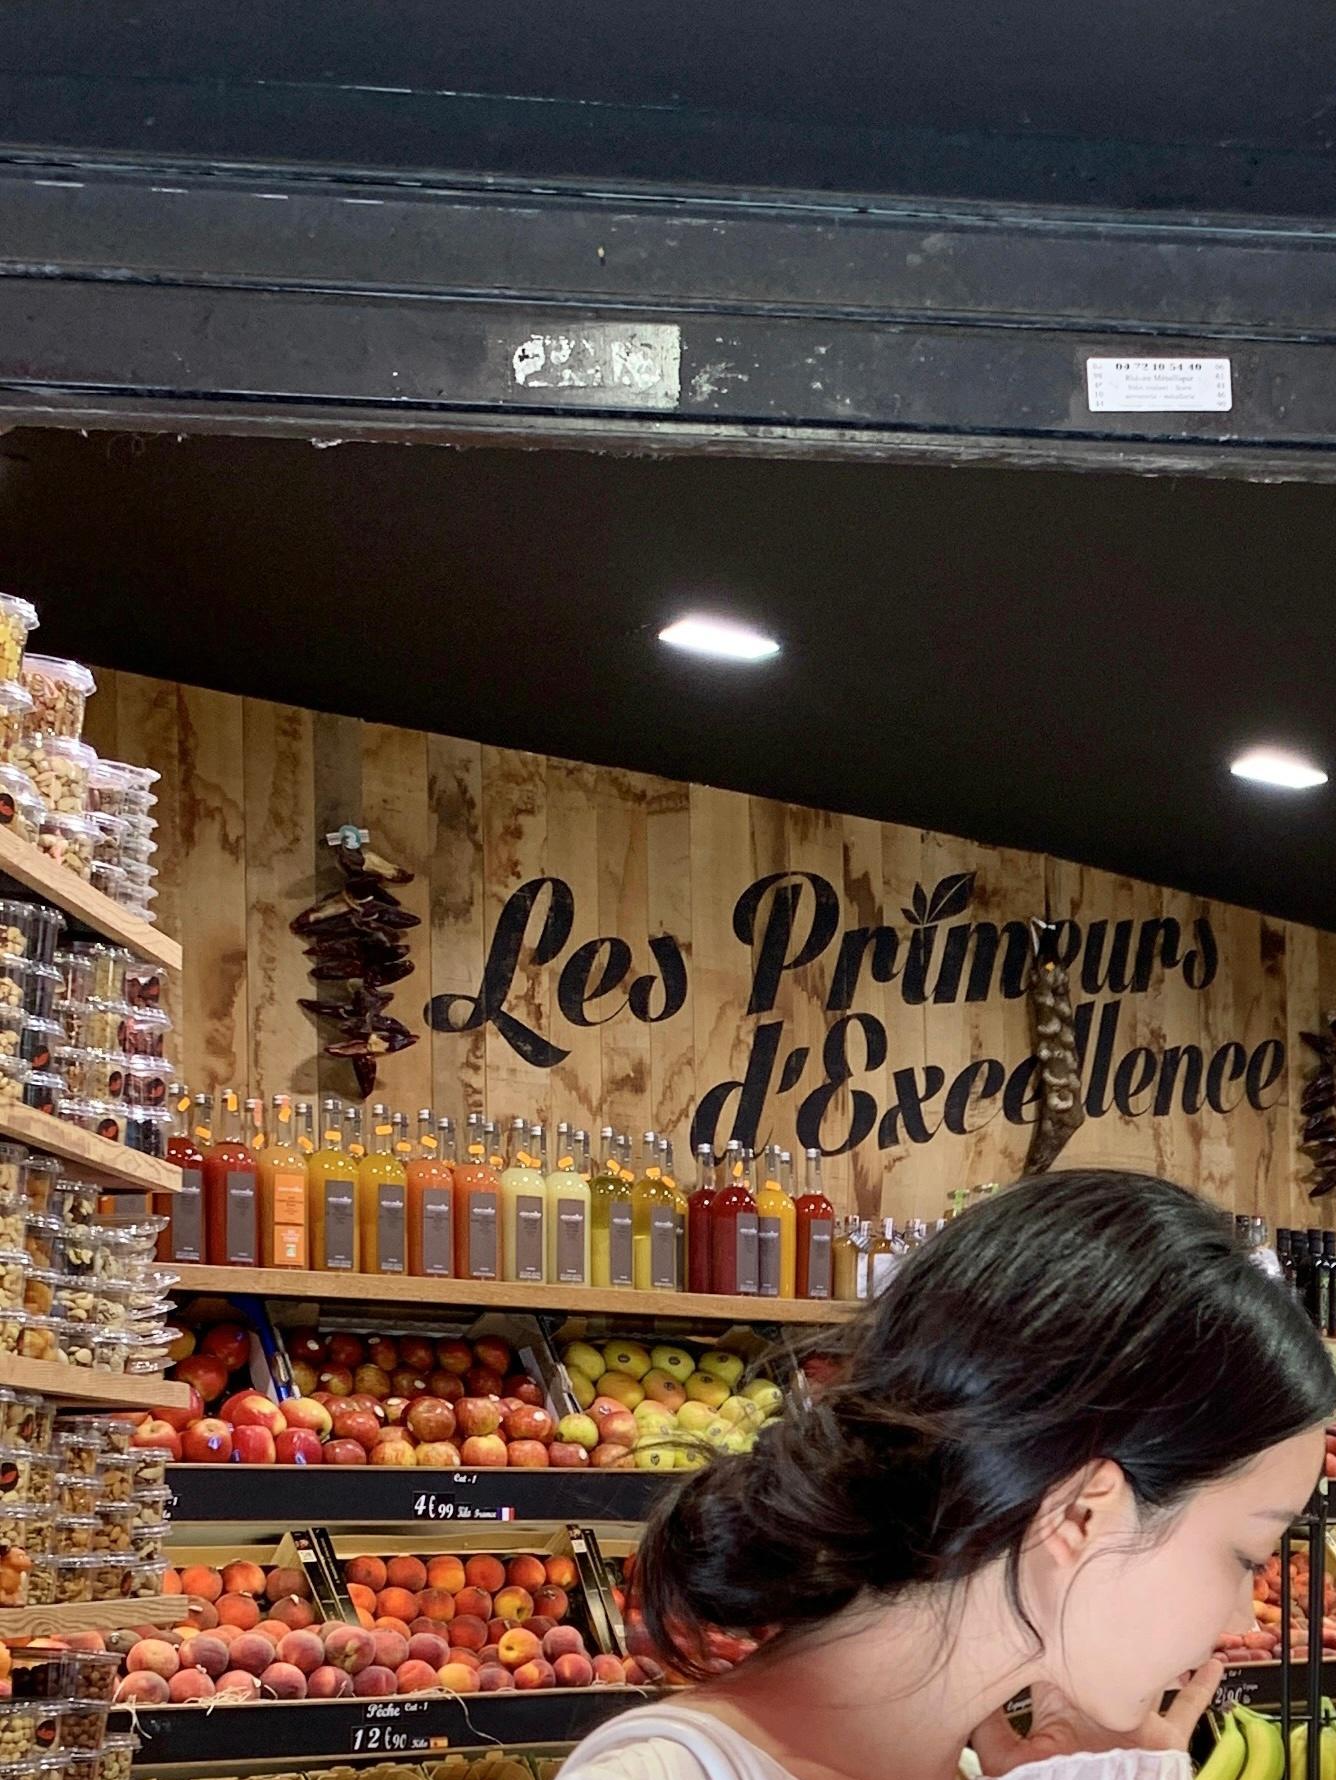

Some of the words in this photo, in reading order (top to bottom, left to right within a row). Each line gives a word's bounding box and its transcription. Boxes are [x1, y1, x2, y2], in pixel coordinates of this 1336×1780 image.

[424, 876, 689, 1069] Les
[689, 1001, 1287, 1160] d'Excellence
[366, 1703, 401, 1718] Pêche
